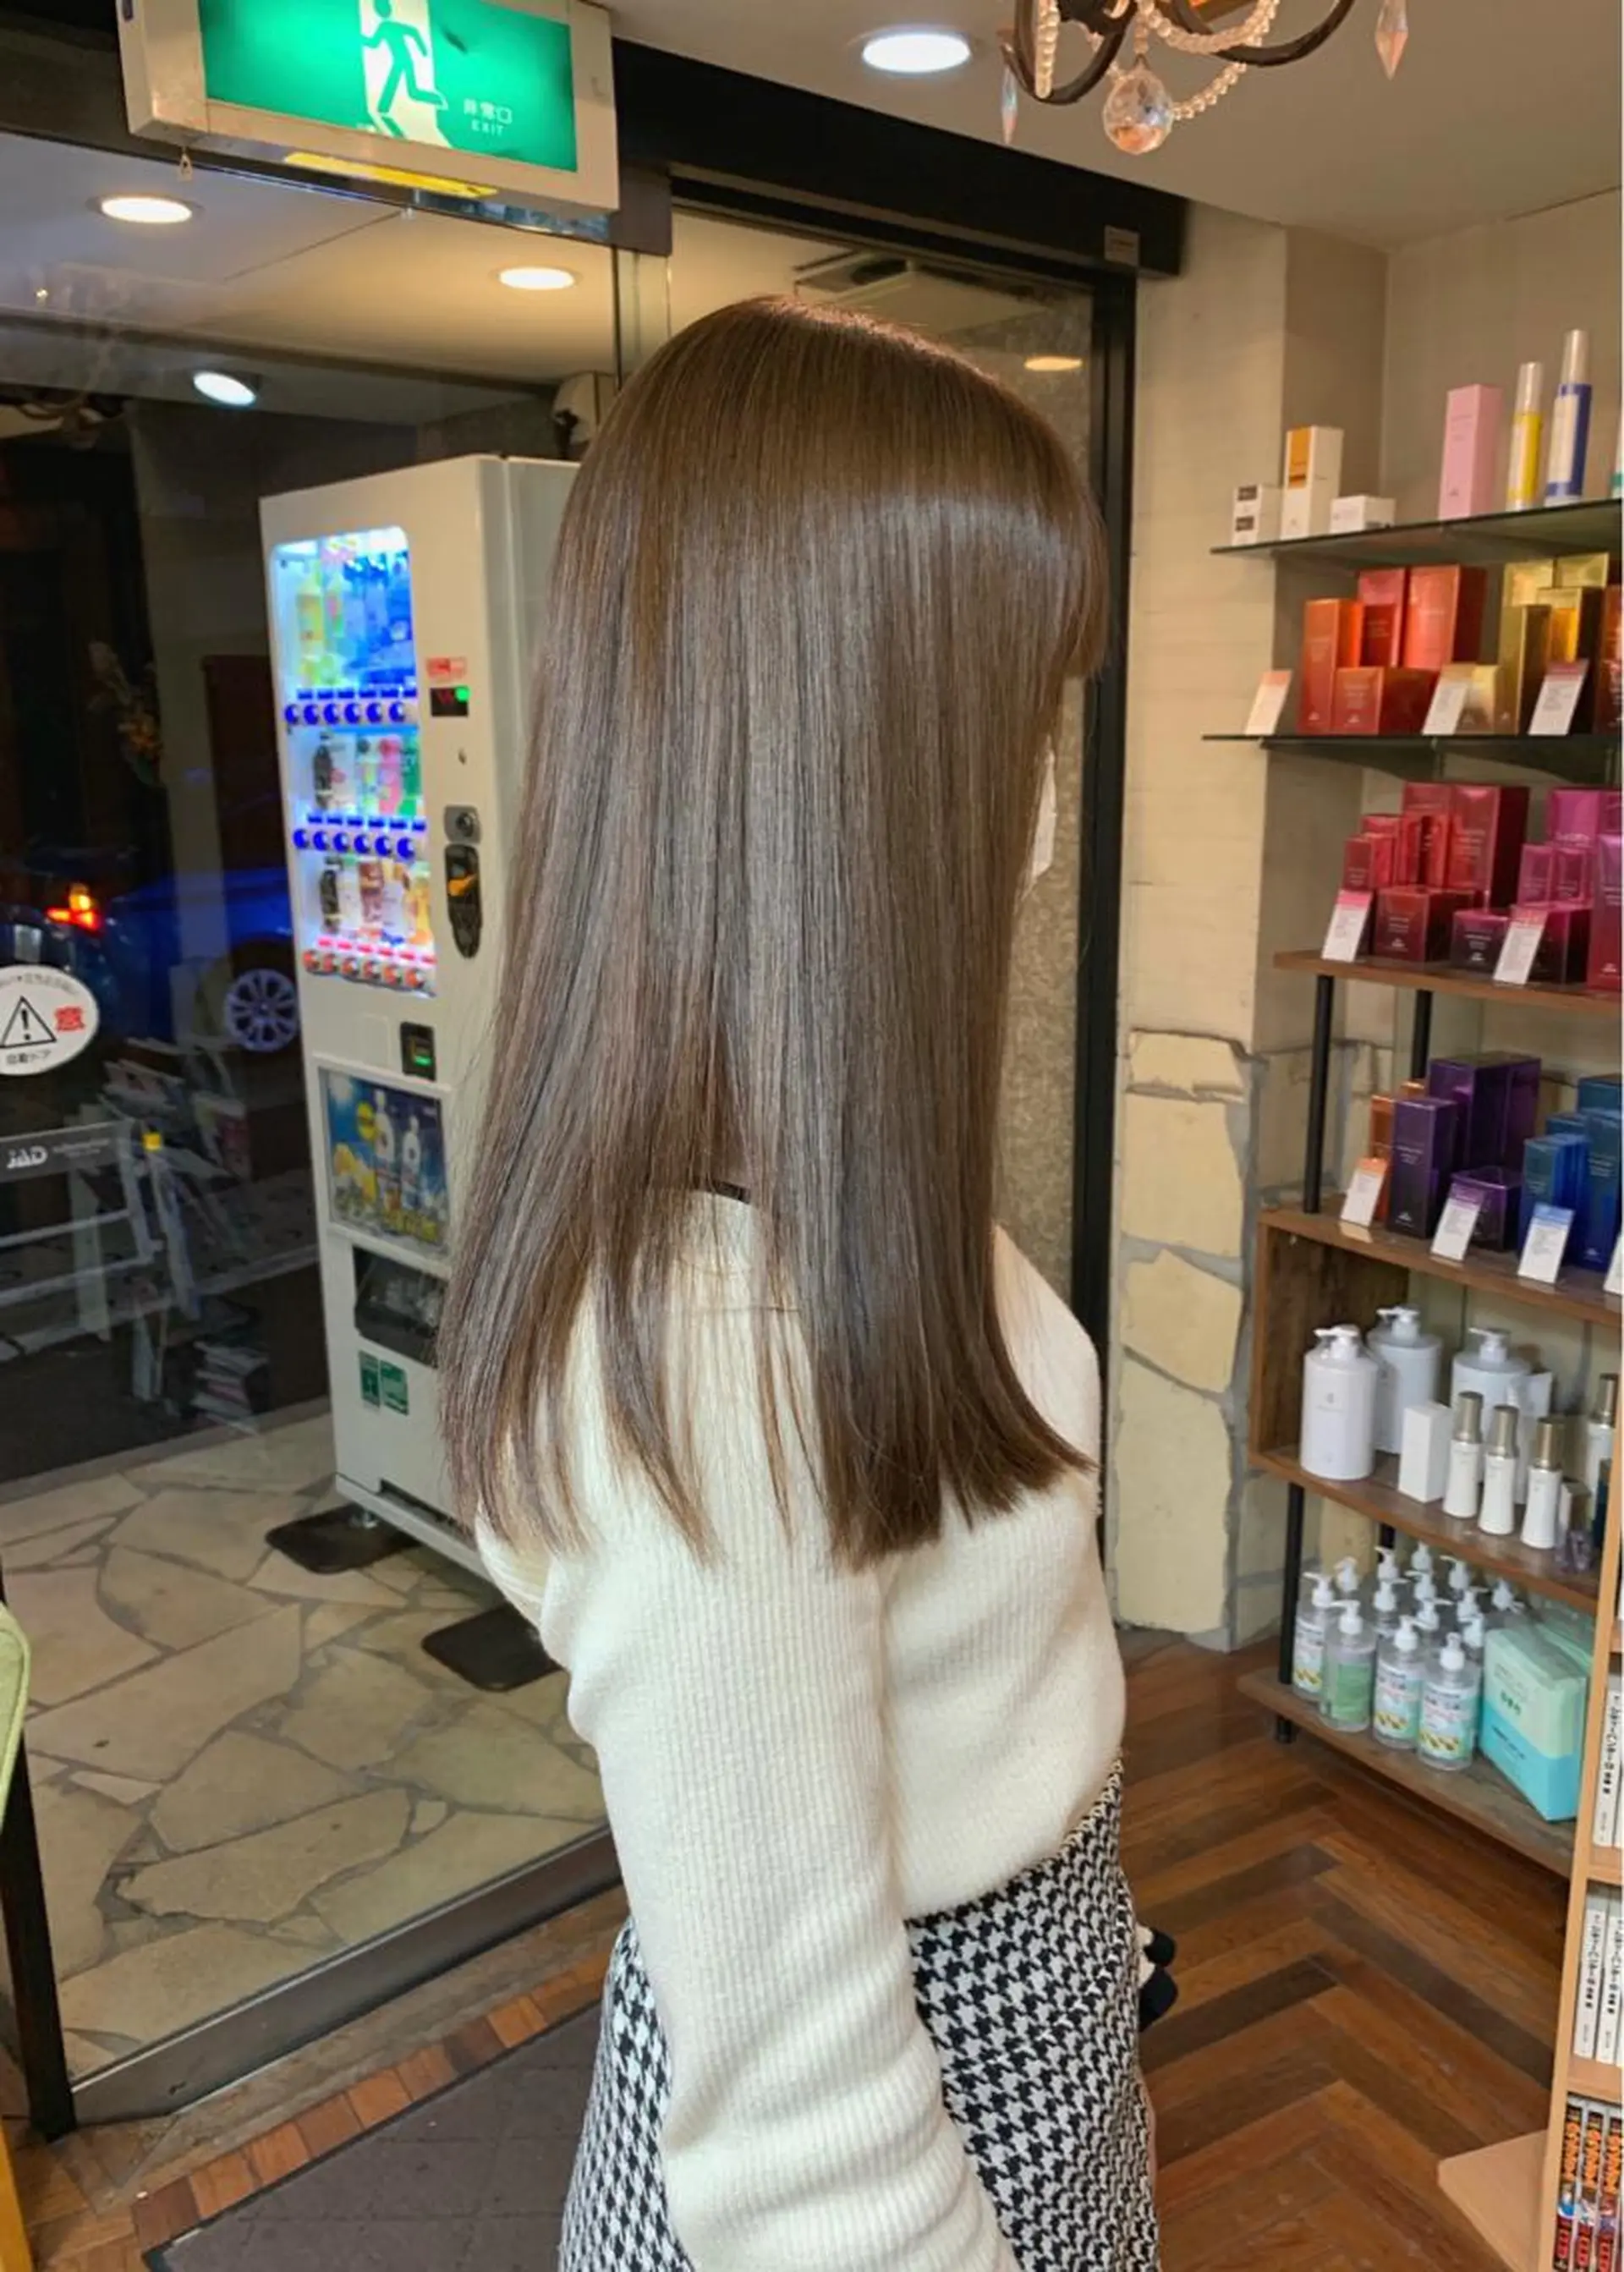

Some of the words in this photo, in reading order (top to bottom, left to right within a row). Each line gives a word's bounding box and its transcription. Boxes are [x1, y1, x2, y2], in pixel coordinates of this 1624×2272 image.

[463, 98, 513, 124] 非常口
[471, 119, 504, 136] EXIT
